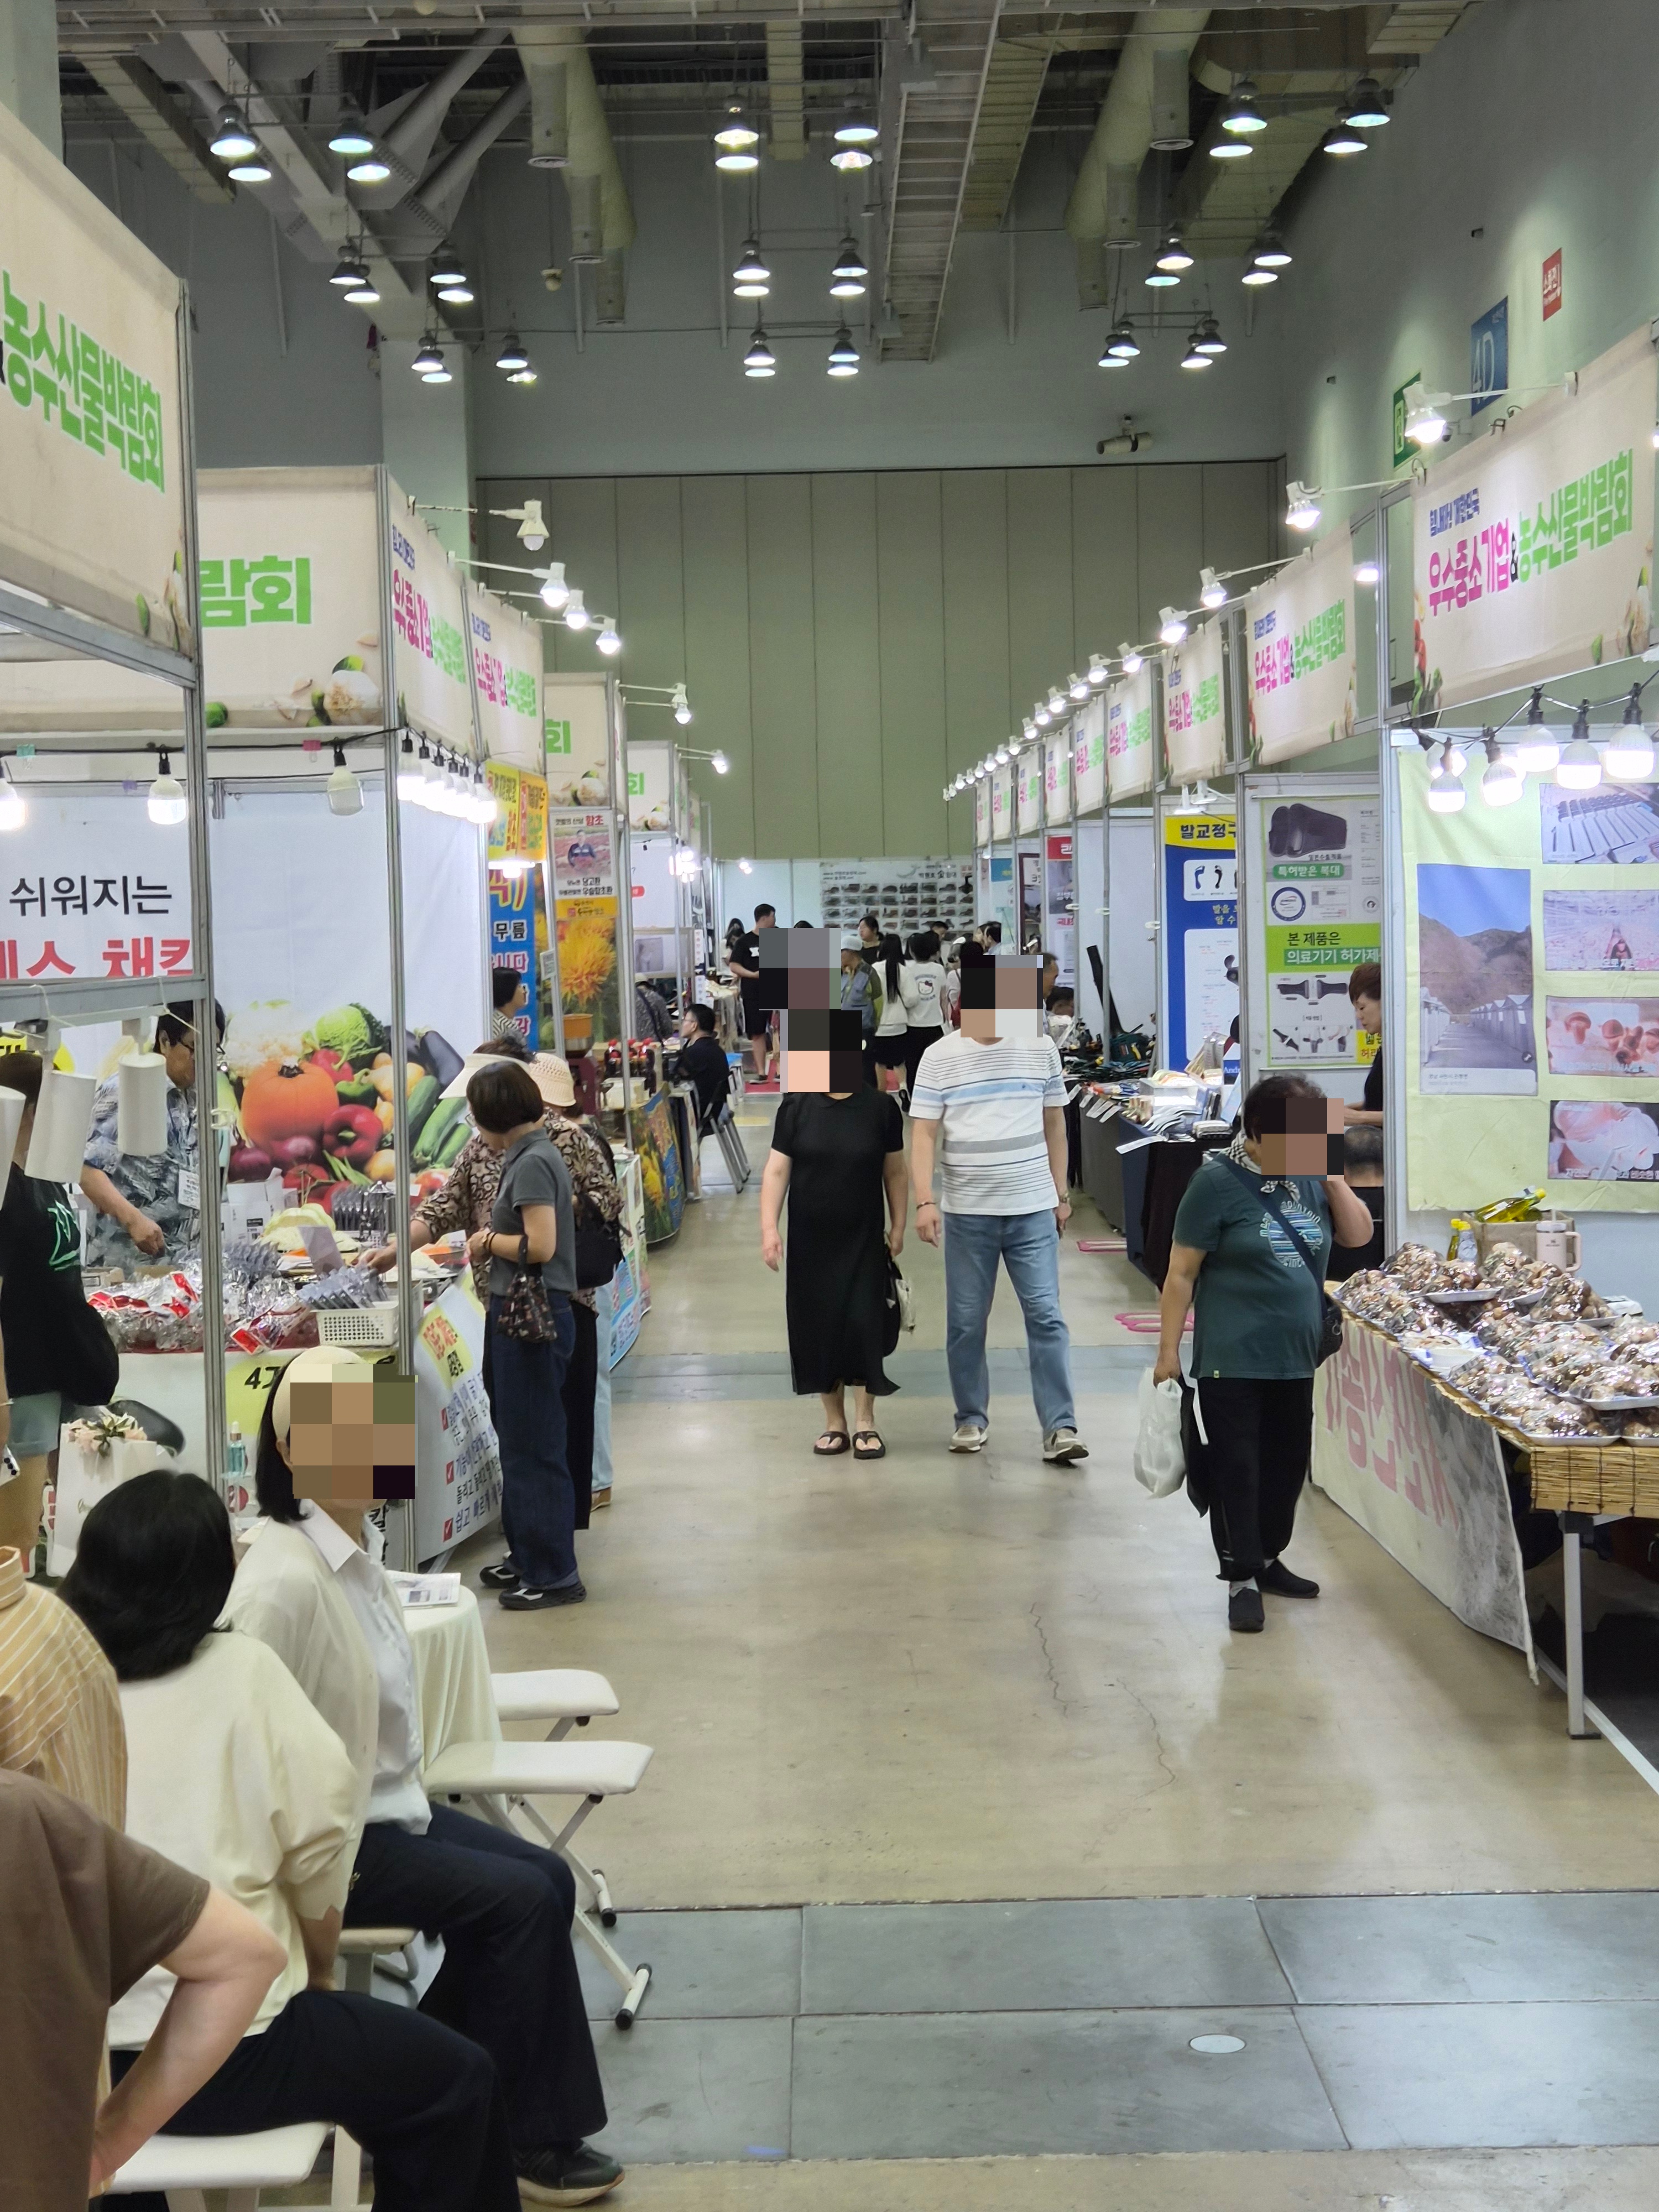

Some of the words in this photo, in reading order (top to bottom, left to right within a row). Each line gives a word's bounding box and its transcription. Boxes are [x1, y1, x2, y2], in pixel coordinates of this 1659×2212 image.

[0, 269, 165, 494] 농수산물박람회
[586, 815, 603, 827] 함초
[1278, 865, 1317, 877] 특허받은
[9, 874, 172, 916] 쉬워지는
[1227, 915, 1235, 925] 수
[1287, 932, 1300, 946] 본
[1303, 932, 1340, 946] 제품은
[492, 953, 526, 971] 니다
[1287, 950, 1337, 964] 의료기기
[1340, 948, 1380, 963] 허가제
